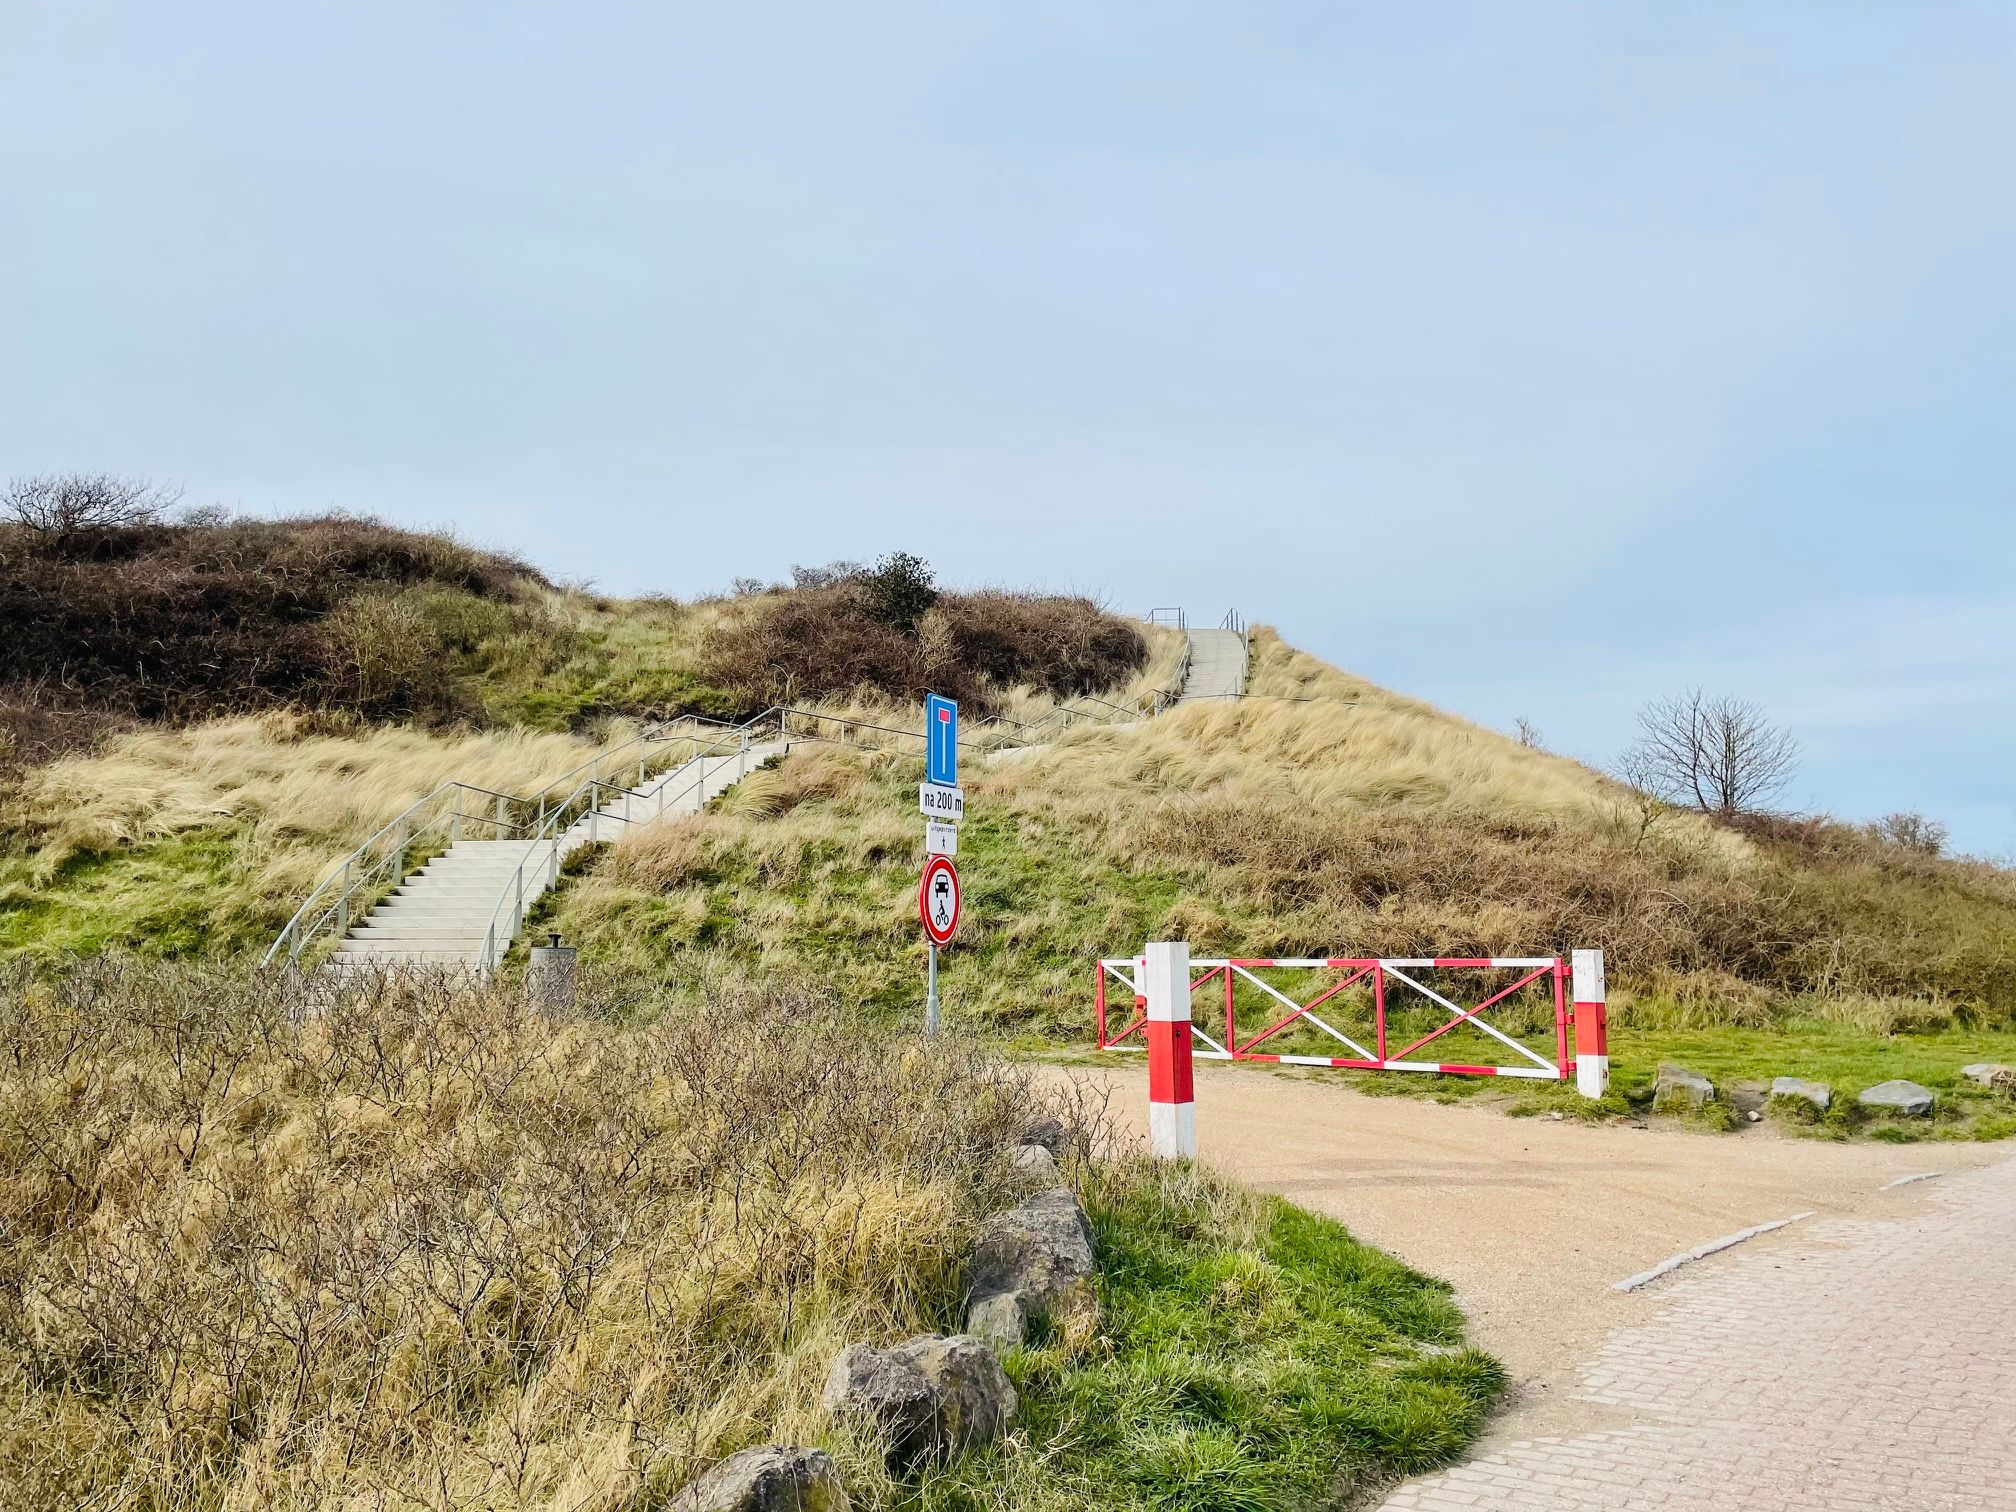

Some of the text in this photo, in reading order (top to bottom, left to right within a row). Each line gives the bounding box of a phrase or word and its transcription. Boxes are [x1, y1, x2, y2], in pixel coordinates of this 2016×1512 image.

[925, 791, 961, 812] na 200 m
